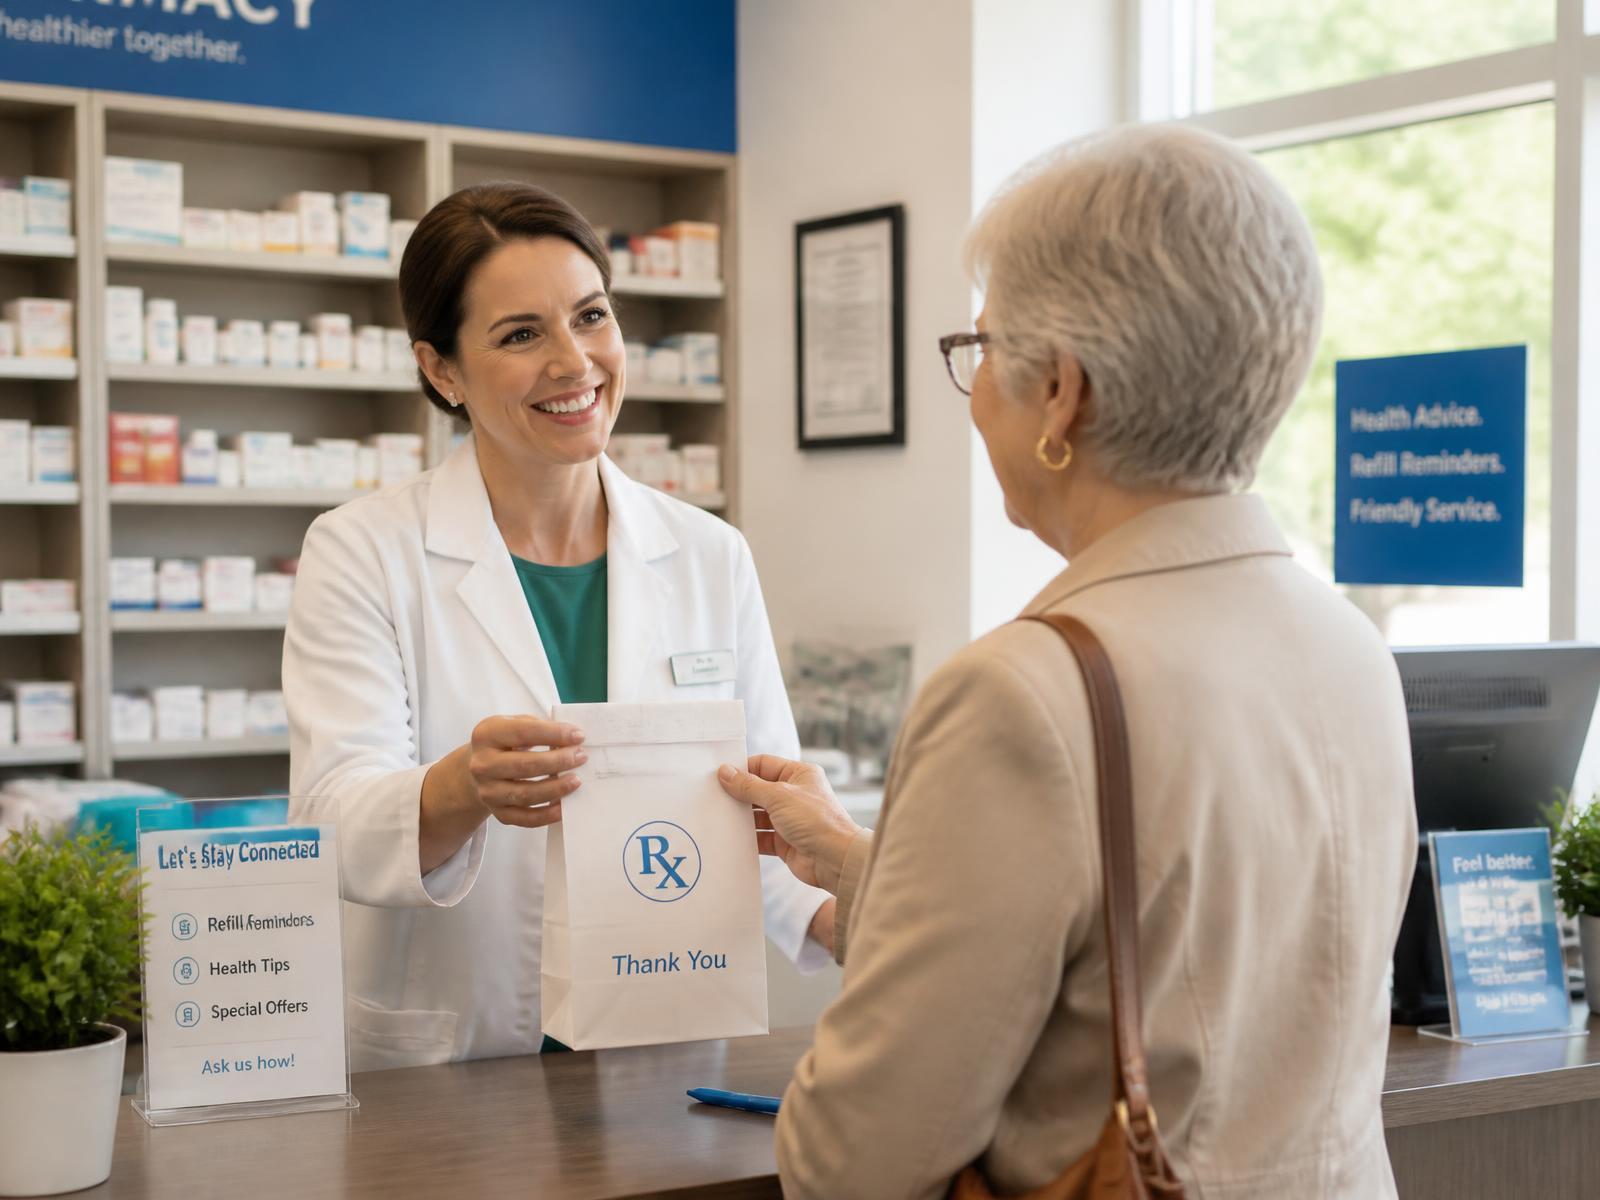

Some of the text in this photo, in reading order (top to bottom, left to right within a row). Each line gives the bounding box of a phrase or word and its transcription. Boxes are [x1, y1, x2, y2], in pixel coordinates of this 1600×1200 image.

[124, 25, 247, 65] together.
[1350, 402, 1484, 432] Health Advice.
[1351, 450, 1505, 477] Refill Reminders.
[1351, 497, 1501, 528] Friendly Service.
[238, 840, 320, 863] Connected
[1452, 852, 1536, 874] Feel better.
[207, 914, 243, 933] Refill
[209, 957, 290, 976] Health Tips
[612, 949, 727, 976] Thank You
[211, 999, 309, 1022] Special Offers
[201, 1053, 295, 1075] Ask us how!
